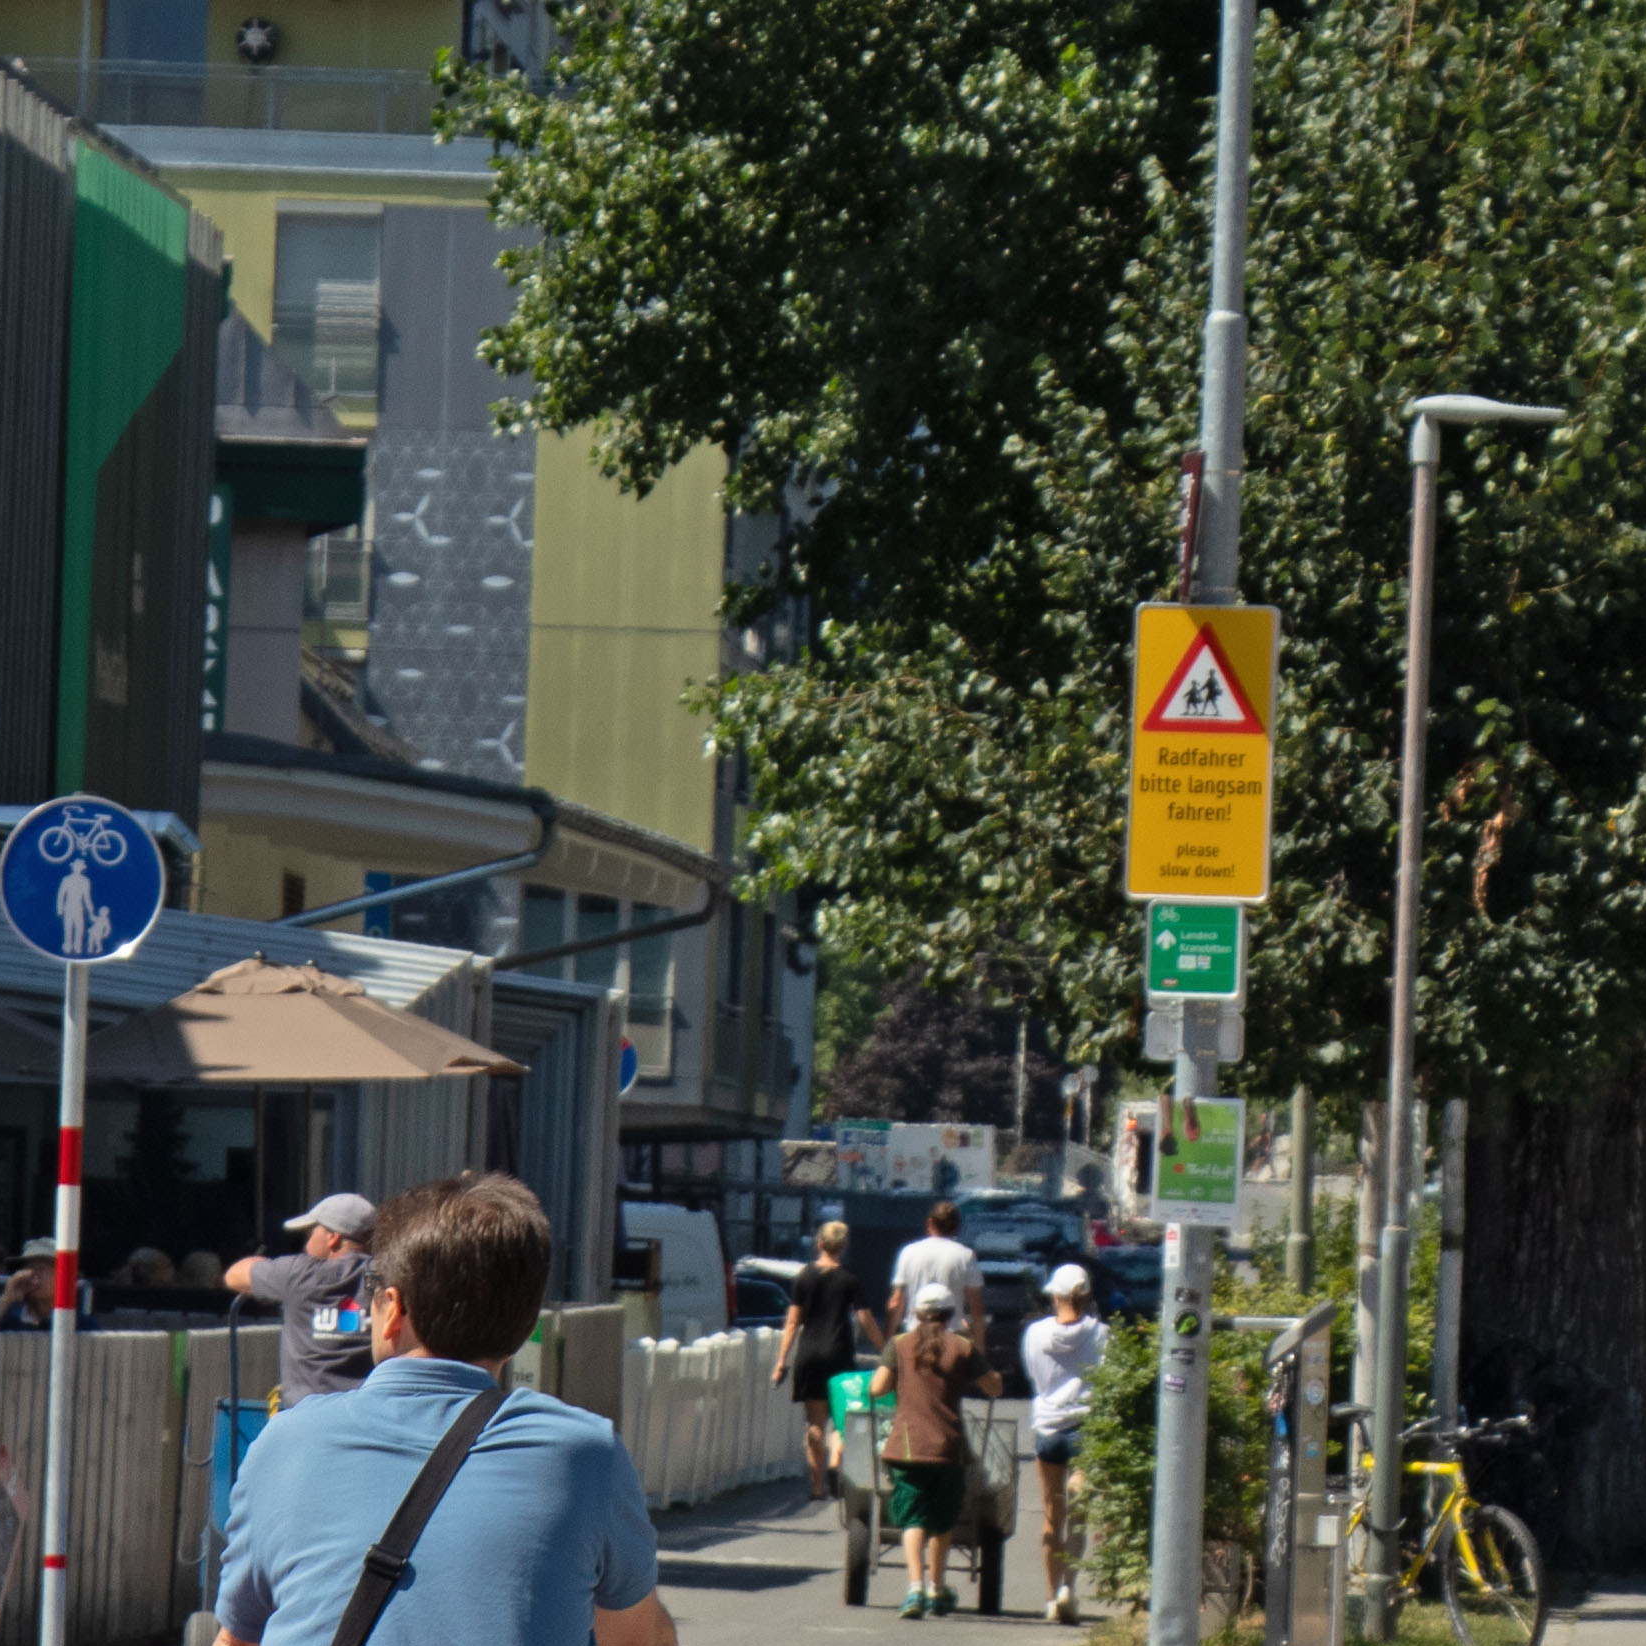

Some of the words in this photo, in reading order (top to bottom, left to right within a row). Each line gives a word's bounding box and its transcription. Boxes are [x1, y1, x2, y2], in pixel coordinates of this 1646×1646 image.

[1158, 747, 1246, 768] Radfahrer
[1140, 775, 1181, 793] bitte
[1188, 776, 1263, 797] langsam
[1167, 803, 1232, 821] fahren!
[1176, 843, 1220, 858] please
[1160, 863, 1191, 877] slow
[1194, 864, 1235, 878] down!
